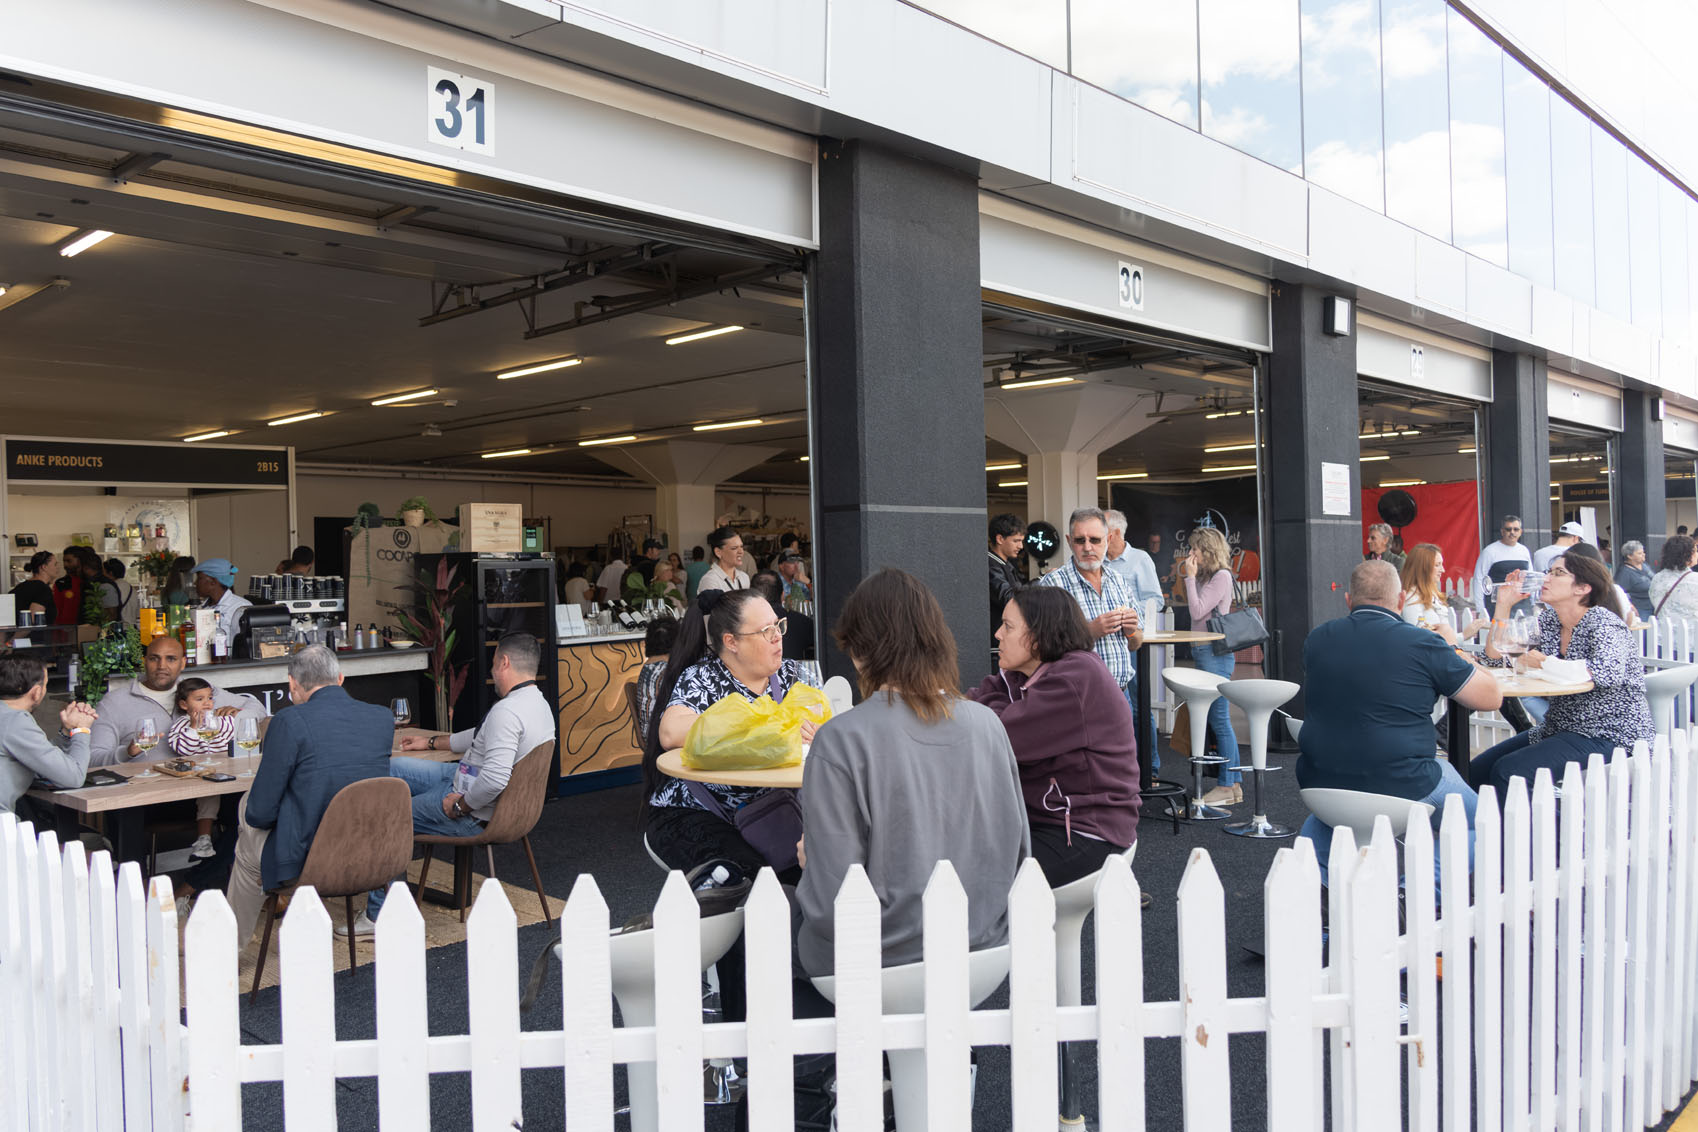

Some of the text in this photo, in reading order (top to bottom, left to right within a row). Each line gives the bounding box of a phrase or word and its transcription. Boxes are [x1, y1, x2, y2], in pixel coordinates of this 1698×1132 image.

[435, 79, 485, 145] 31
[1120, 267, 1142, 305] 30
[16, 454, 103, 468] ANKE PRODUCTS
[257, 462, 279, 473] 2B15
